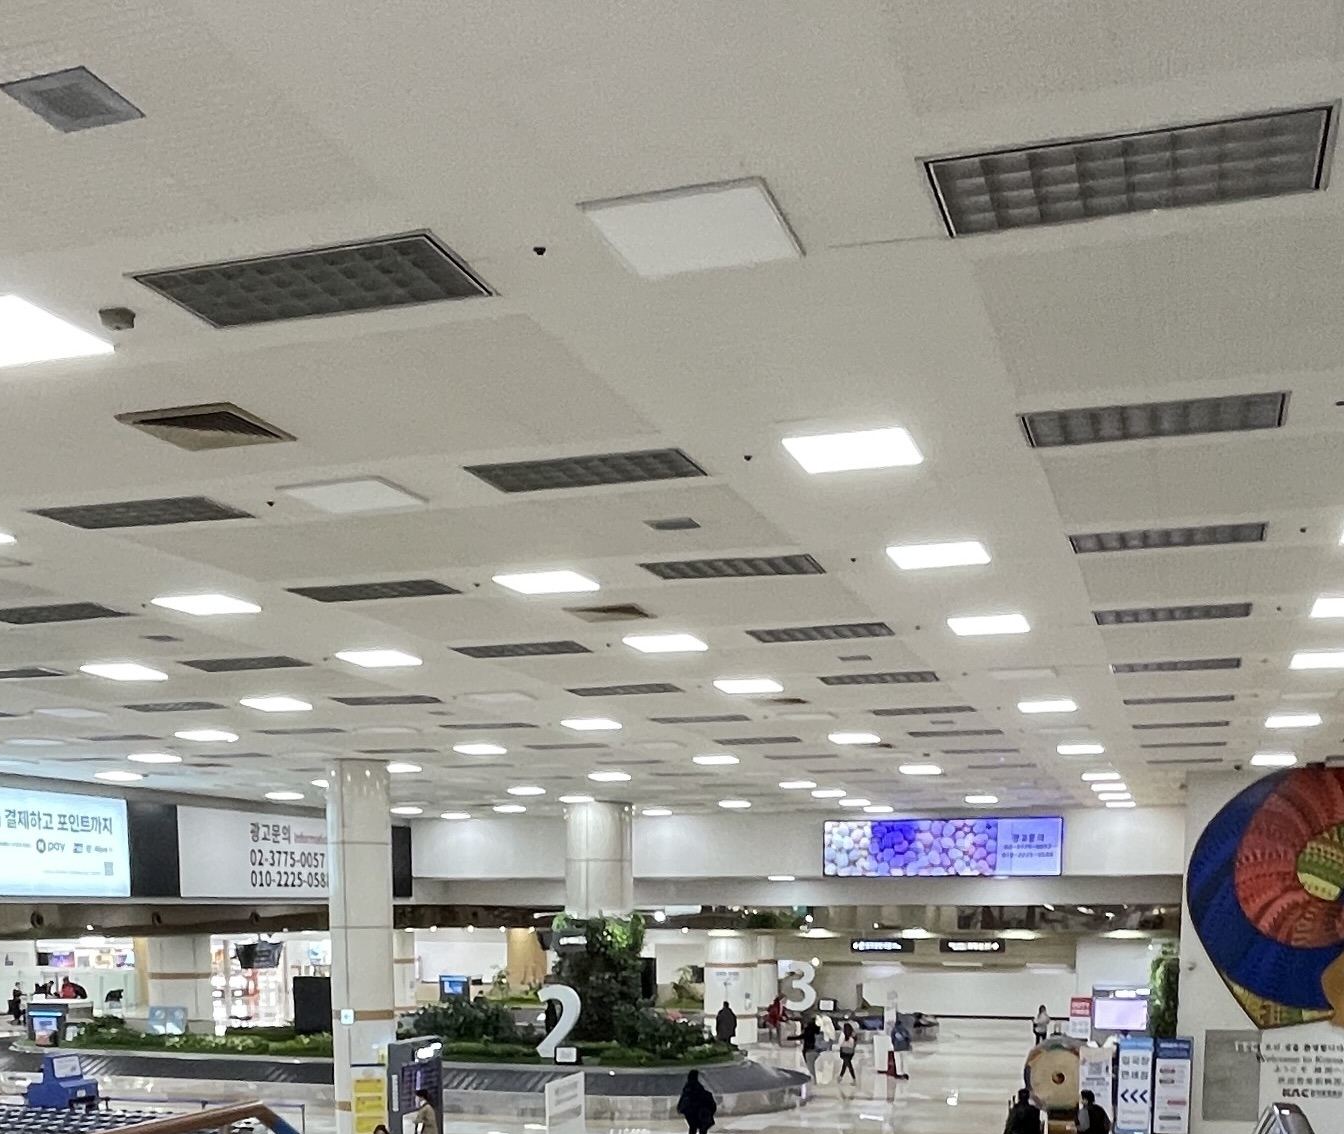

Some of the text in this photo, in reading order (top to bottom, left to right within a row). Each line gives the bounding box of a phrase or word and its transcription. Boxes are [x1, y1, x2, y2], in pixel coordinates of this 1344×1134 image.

[4, 808, 54, 831] 결제하고
[57, 813, 113, 835] 포인트까지
[249, 822, 292, 845] 광고문의
[249, 849, 326, 868] 02-3775-0057
[250, 870, 330, 888] 010-2225-058
[785, 959, 817, 1012] 3
[536, 984, 582, 1059] 2
